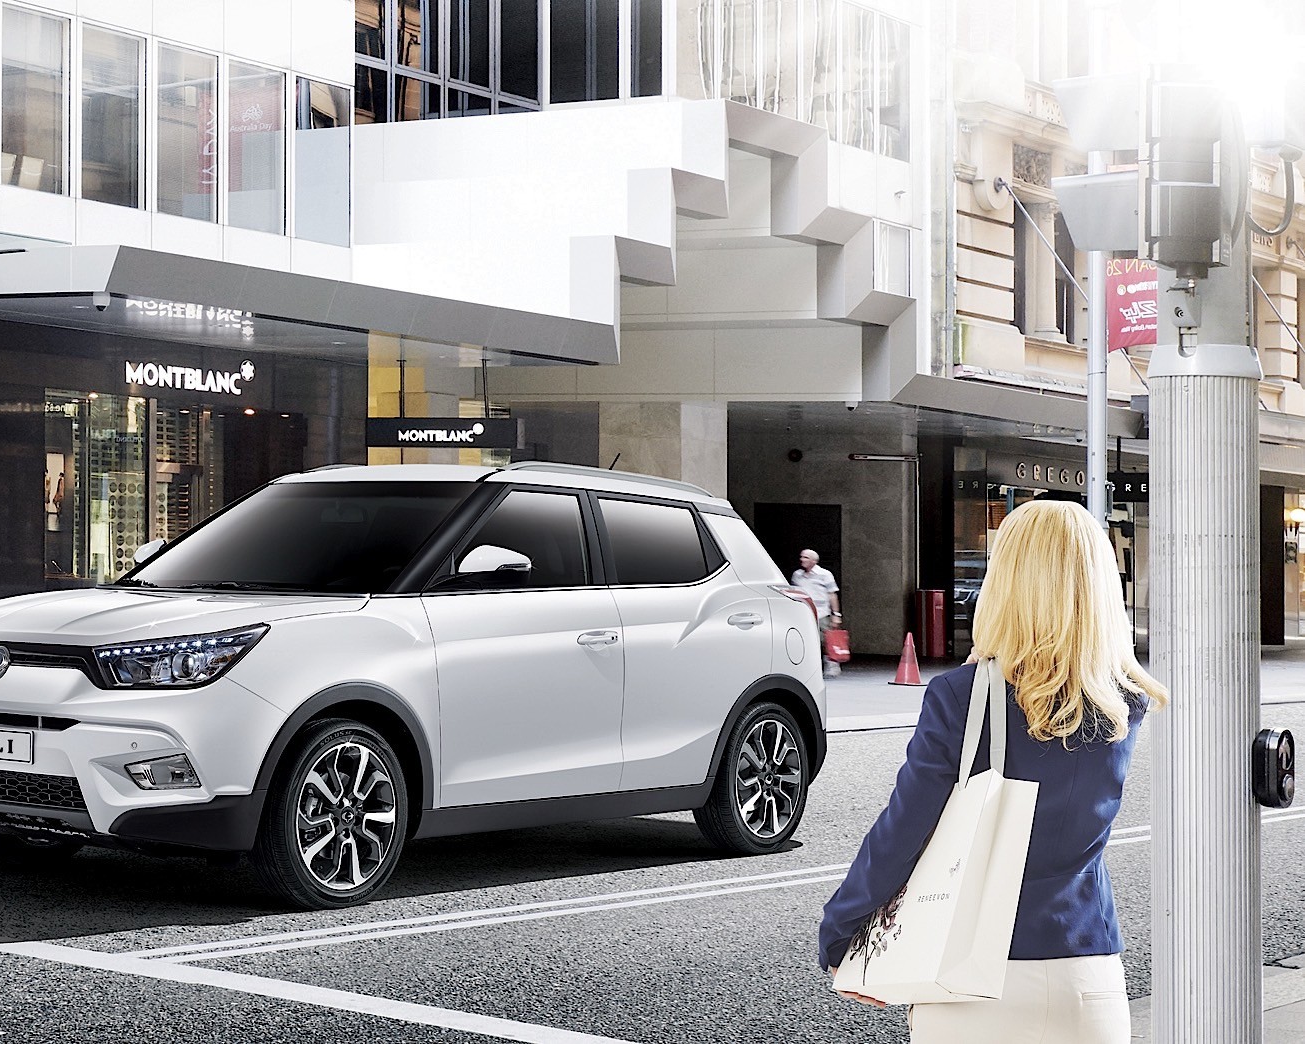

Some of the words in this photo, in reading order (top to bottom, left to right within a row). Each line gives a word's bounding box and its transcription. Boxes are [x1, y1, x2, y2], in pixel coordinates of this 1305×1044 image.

[259, 122, 273, 131] Day
[125, 361, 242, 395] MONTBLANC
[398, 429, 475, 442] MONTBLANC
